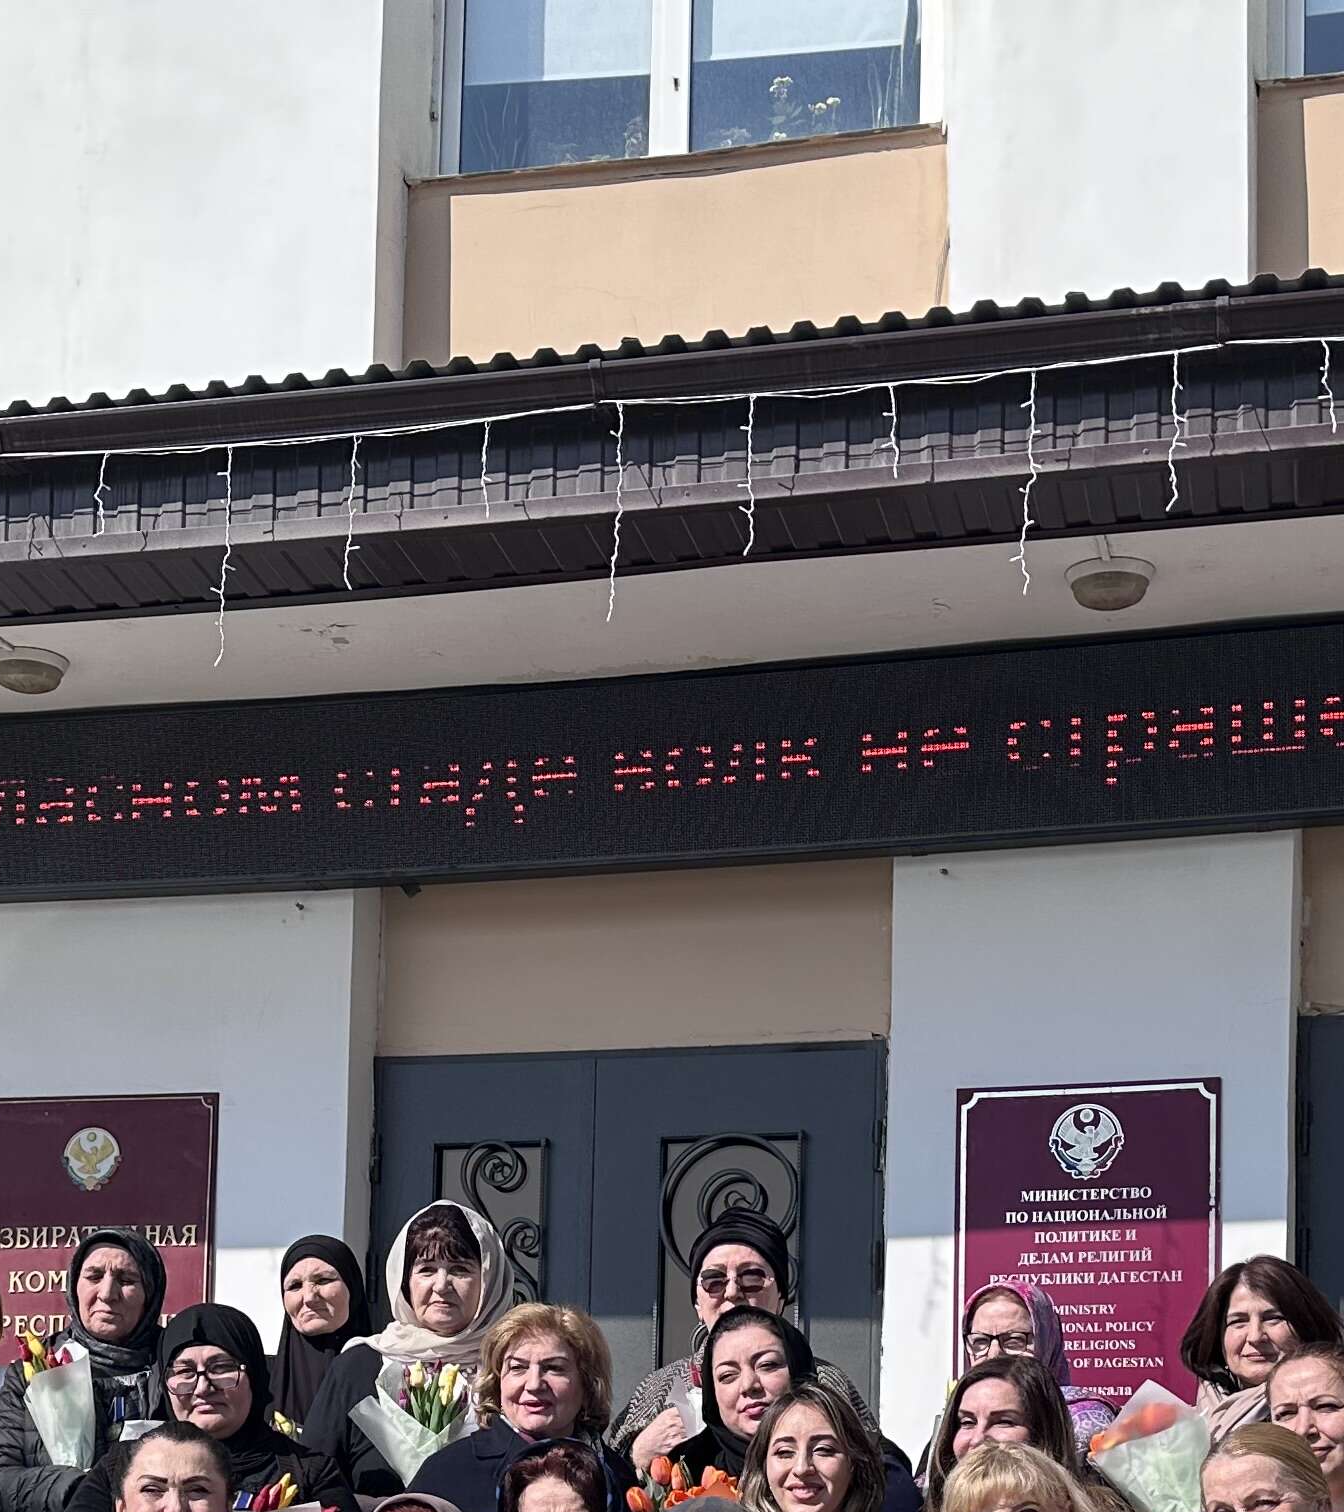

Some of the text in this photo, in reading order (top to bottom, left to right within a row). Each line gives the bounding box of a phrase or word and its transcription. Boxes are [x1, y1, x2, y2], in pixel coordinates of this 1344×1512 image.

[1020, 1186, 1152, 1203] МИНИСТЕРСТВО
[1006, 1205, 1167, 1224] ПО НАЦИОНАЛЬНОЙ
[1034, 1228, 1137, 1244] ПОЛИТИКЕ И
[1017, 1247, 1152, 1268] ДЕЛАМ РЕЛИГИЙ
[1097, 1270, 1183, 1286] ДАГЕСТАН
[1105, 1321, 1155, 1332] POLICY
[1063, 1339, 1136, 1351] RELIGIONS
[1073, 1356, 1164, 1369] OF DAGESTAN
